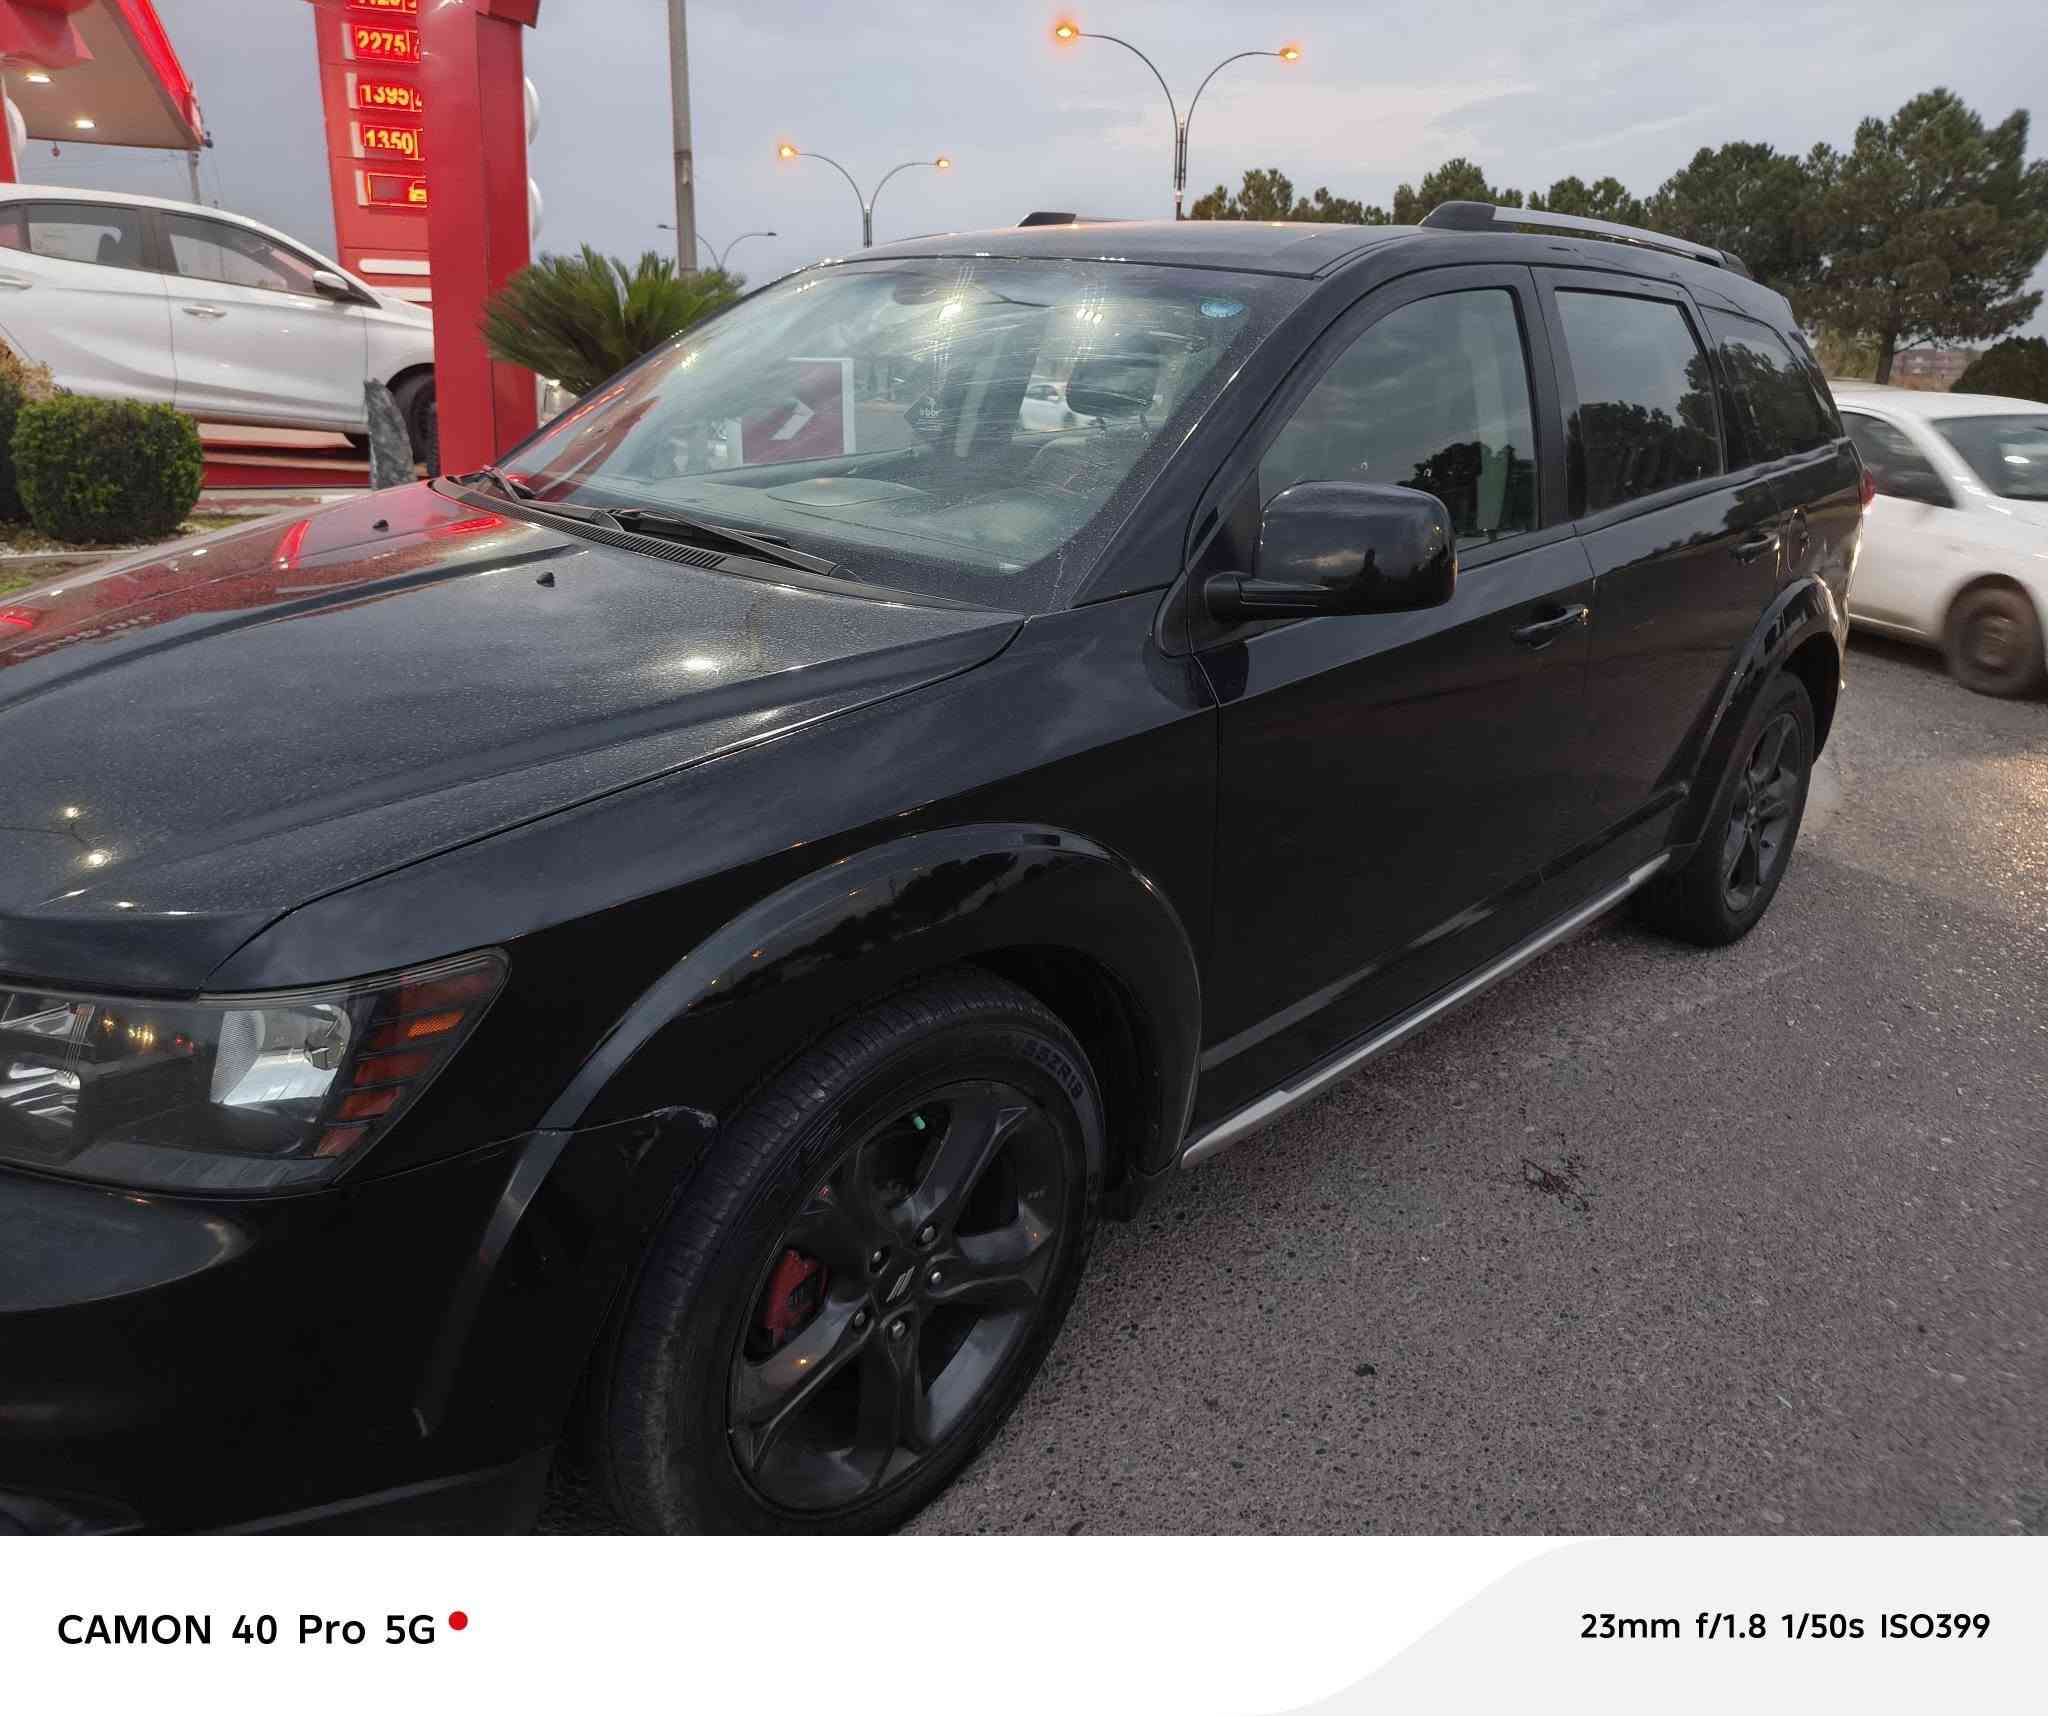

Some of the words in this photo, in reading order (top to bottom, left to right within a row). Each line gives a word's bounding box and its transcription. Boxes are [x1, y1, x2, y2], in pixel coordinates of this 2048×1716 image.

[358, 31, 407, 55] 2275
[361, 84, 409, 106] 1395
[366, 130, 413, 154] 1350
